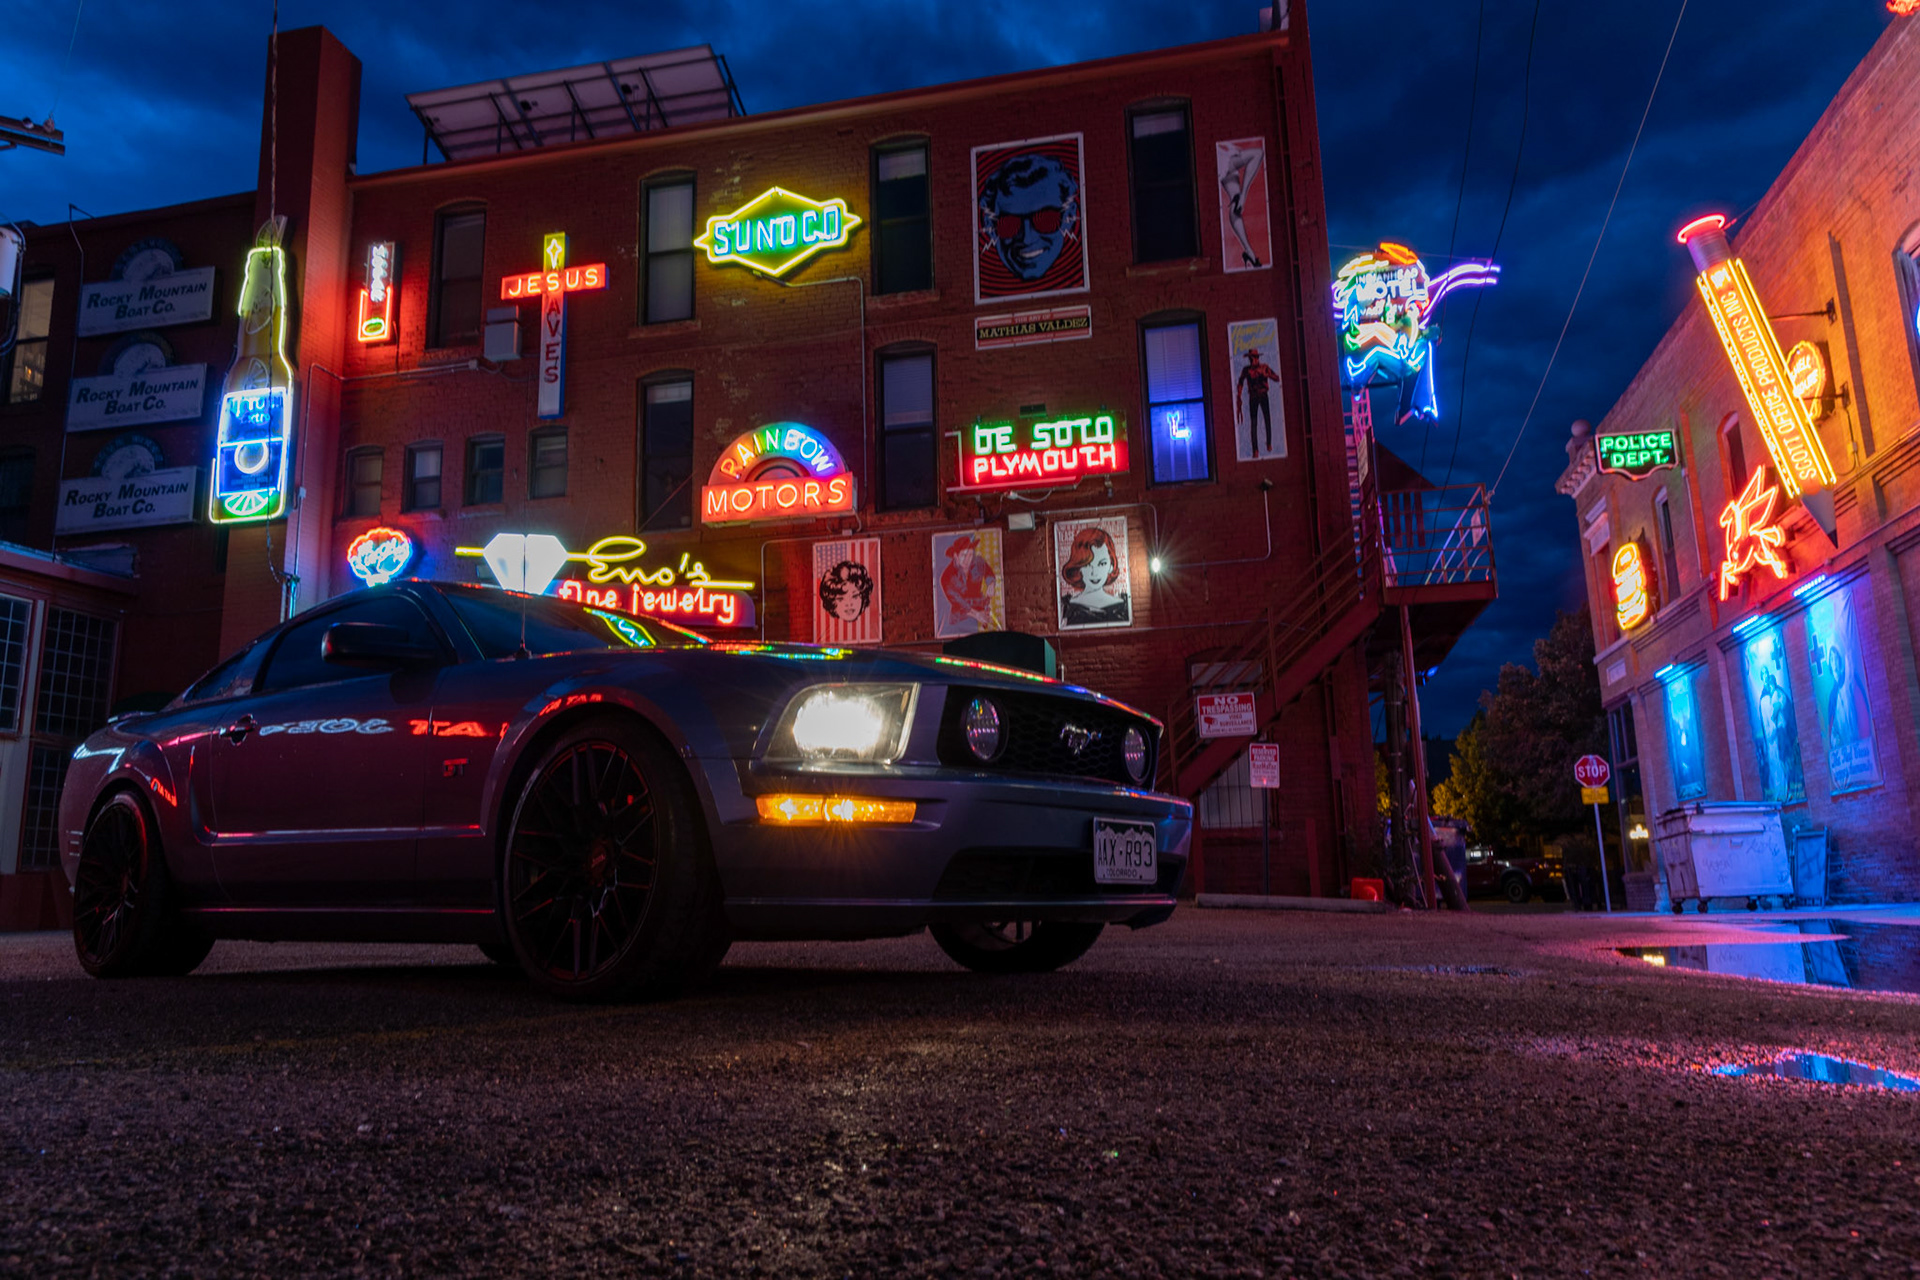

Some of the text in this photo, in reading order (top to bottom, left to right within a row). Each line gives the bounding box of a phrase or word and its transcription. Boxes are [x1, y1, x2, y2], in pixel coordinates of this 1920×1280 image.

[713, 204, 842, 256] SUNOCO
[508, 268, 599, 296] JESUS
[1356, 278, 1429, 301] MOTEL
[979, 322, 1036, 339] MATHIAS
[1038, 317, 1088, 332] VALDEZ
[1732, 315, 1776, 387] PRODUCTS
[1761, 385, 1796, 435] OFFICE
[720, 428, 837, 480] RAINBOW
[974, 415, 1114, 455] DE SOTO
[1600, 431, 1672, 453] POLICE
[973, 443, 1117, 483] PLYMOUTH
[1783, 435, 1818, 480] SCOTT
[707, 478, 847, 515] MOTORS
[586, 536, 713, 587] Eno's
[1202, 703, 1252, 714] TRESPASSING
[1214, 696, 1239, 705] NO
[1577, 764, 1607, 778] STOP
